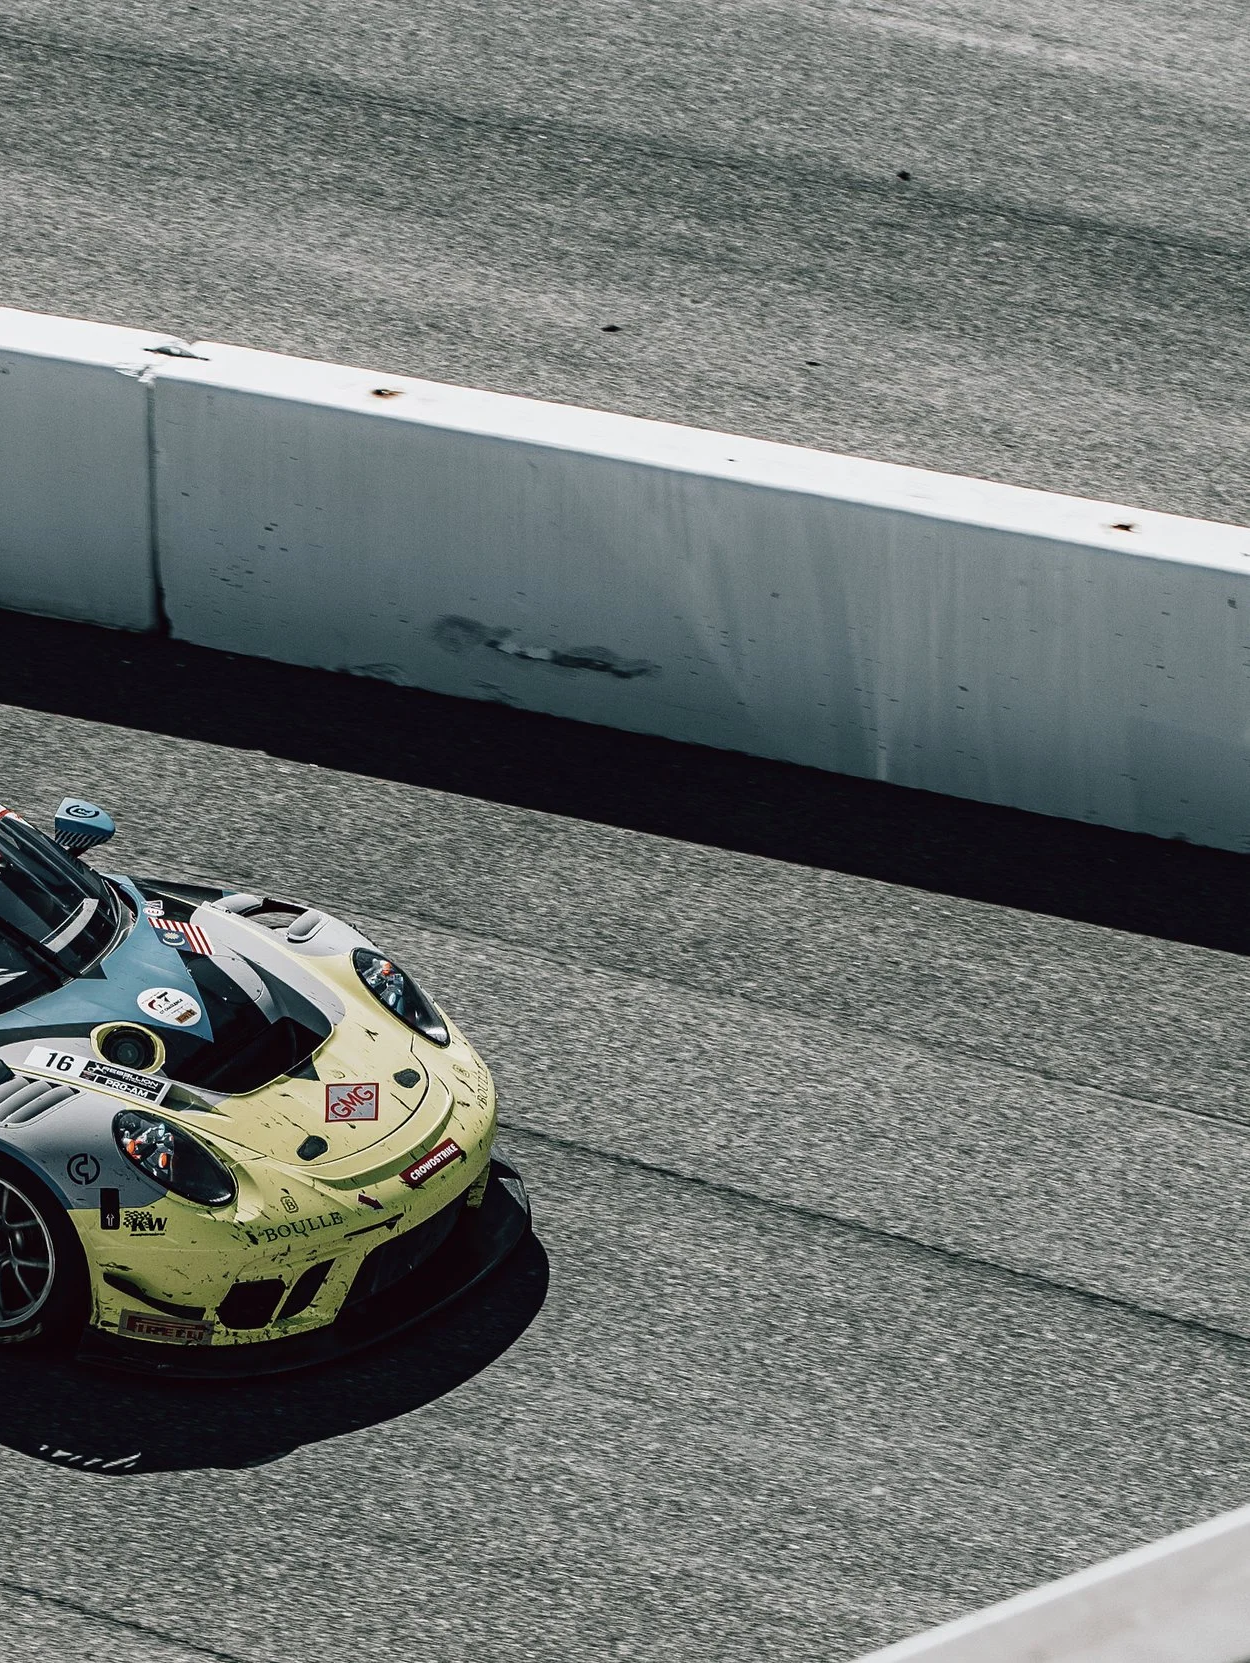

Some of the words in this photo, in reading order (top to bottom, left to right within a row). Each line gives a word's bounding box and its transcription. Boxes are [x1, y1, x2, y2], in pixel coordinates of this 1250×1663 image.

[45, 1052, 74, 1072] 16
[102, 1065, 159, 1088] REBELLION
[105, 1079, 148, 1098] PRO-AM
[330, 1086, 374, 1118] GMG
[410, 1143, 458, 1181] CROWDSTRIKE
[131, 1217, 168, 1232] KW
[263, 1211, 344, 1243] BOULLE
[126, 1315, 205, 1340] PIRELLI
